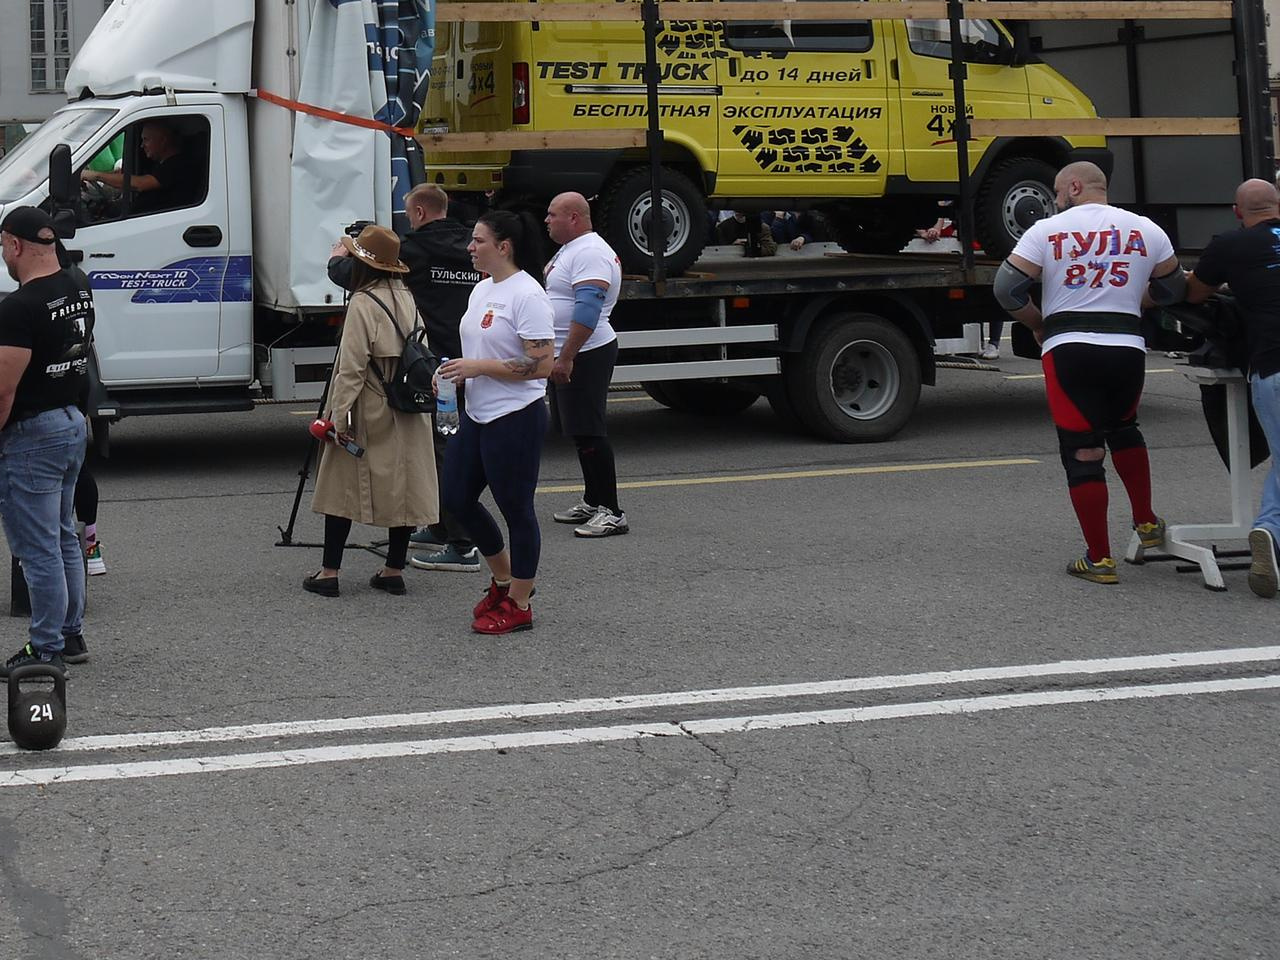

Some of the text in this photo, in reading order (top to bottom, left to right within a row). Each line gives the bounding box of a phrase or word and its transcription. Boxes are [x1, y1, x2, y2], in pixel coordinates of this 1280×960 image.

[537, 62, 607, 79] TEST
[740, 68, 861, 82] до 14 дней
[723, 106, 882, 121] ЭКСПЛУАТАЦИЯ
[931, 104, 974, 114] НОВЙ
[1048, 225, 1148, 261] ТУЛА
[174, 271, 188, 279] 10
[1064, 260, 1131, 289] 875
[121, 280, 187, 288] TEST-TRUCK
[30, 703, 54, 723] 24
